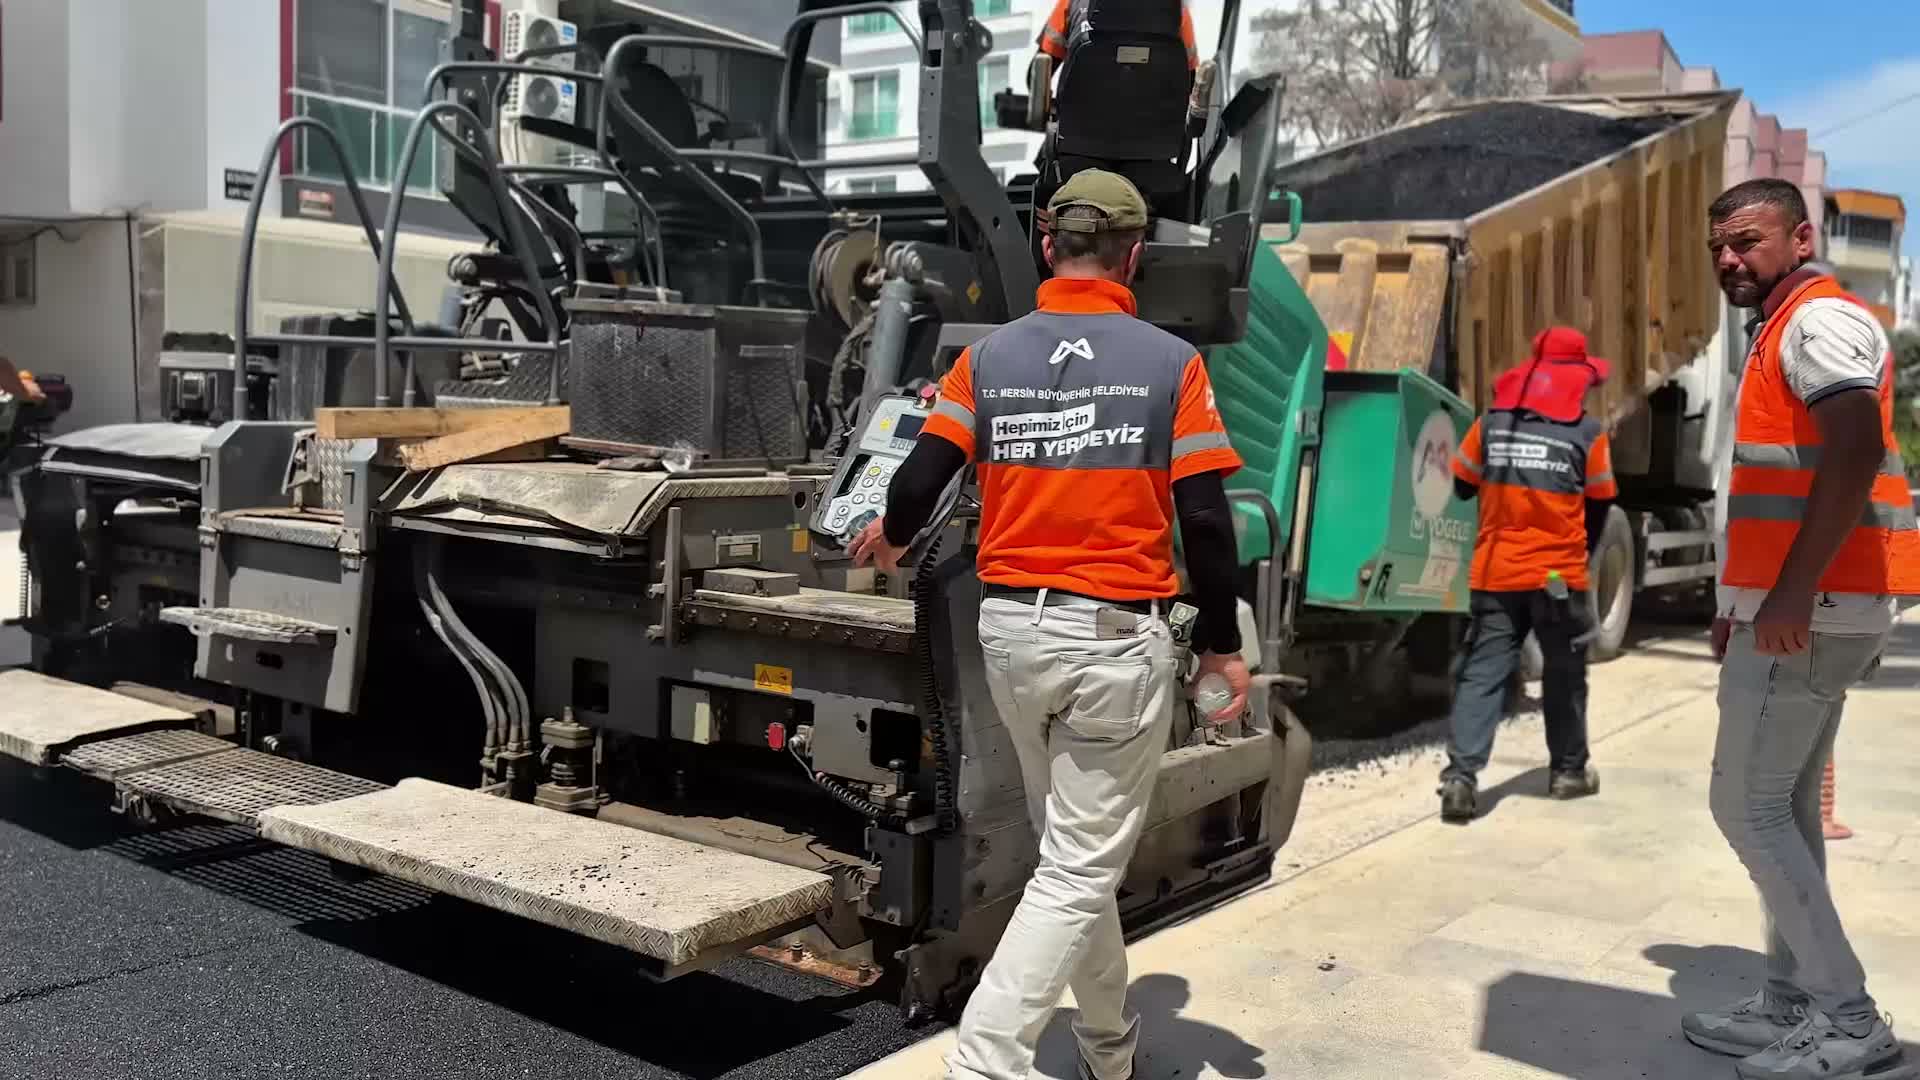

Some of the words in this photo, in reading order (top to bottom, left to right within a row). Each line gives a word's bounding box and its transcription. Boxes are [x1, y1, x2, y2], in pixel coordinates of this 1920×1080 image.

[982, 389, 998, 399] T.C.
[1000, 387, 1035, 399] MERSİN
[1093, 384, 1149, 397] BELEDİYESİ
[995, 418, 1060, 436] Hepimiz
[992, 442, 1036, 460] HER
[1043, 423, 1145, 457] YERDEYİZ
